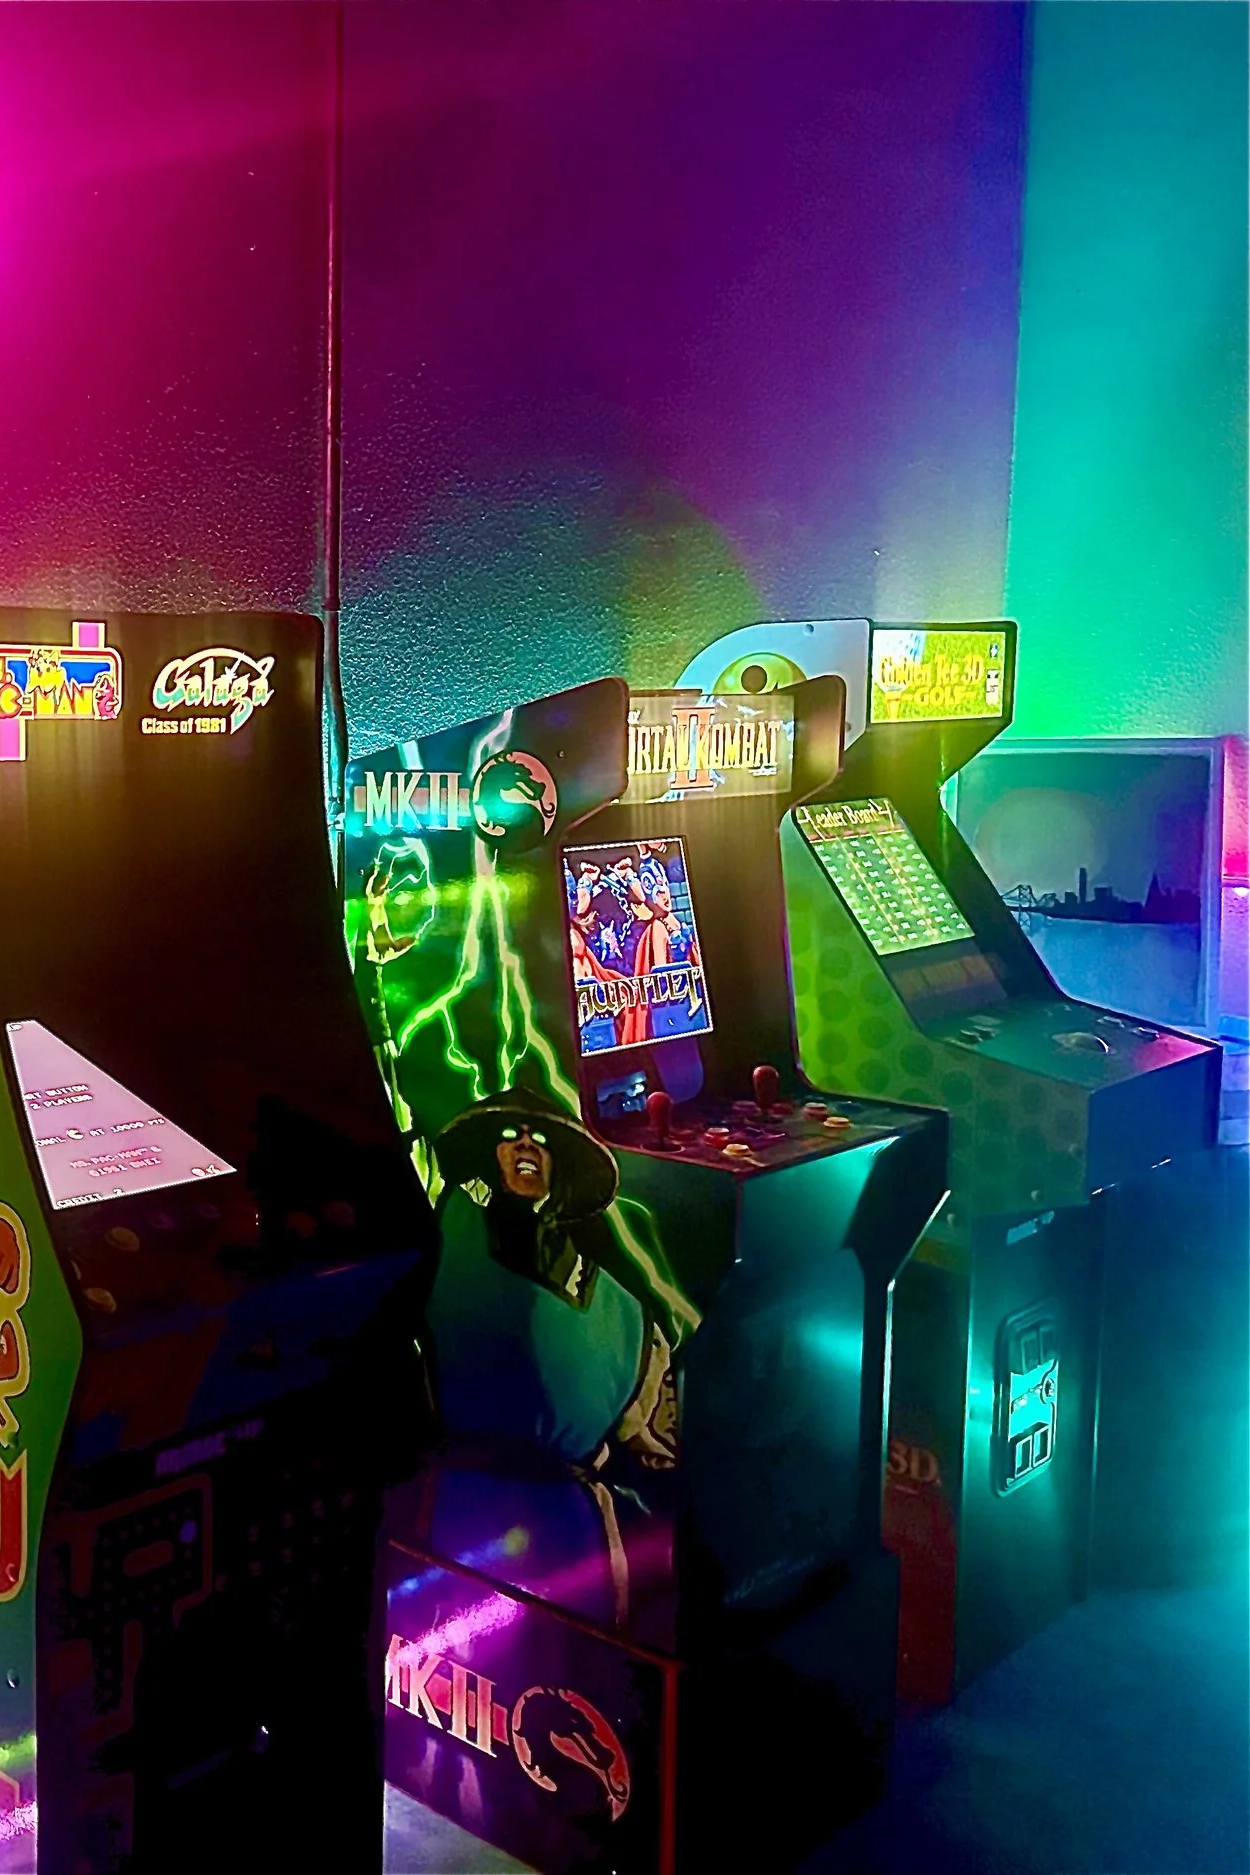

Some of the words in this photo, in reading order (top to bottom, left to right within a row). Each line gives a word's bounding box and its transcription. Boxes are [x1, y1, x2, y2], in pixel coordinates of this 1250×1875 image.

[935, 653, 959, 686] Tee
[152, 649, 275, 735] Galaga
[142, 717, 179, 734] Class
[180, 717, 195, 734] of
[195, 717, 227, 734] 1981
[628, 724, 691, 775] RTAL
[695, 721, 781, 770] KOMBAT
[576, 967, 703, 1028] AUNTLET
[44, 1084, 89, 1097] BUTTON
[56, 1192, 103, 1208] CREDIT
